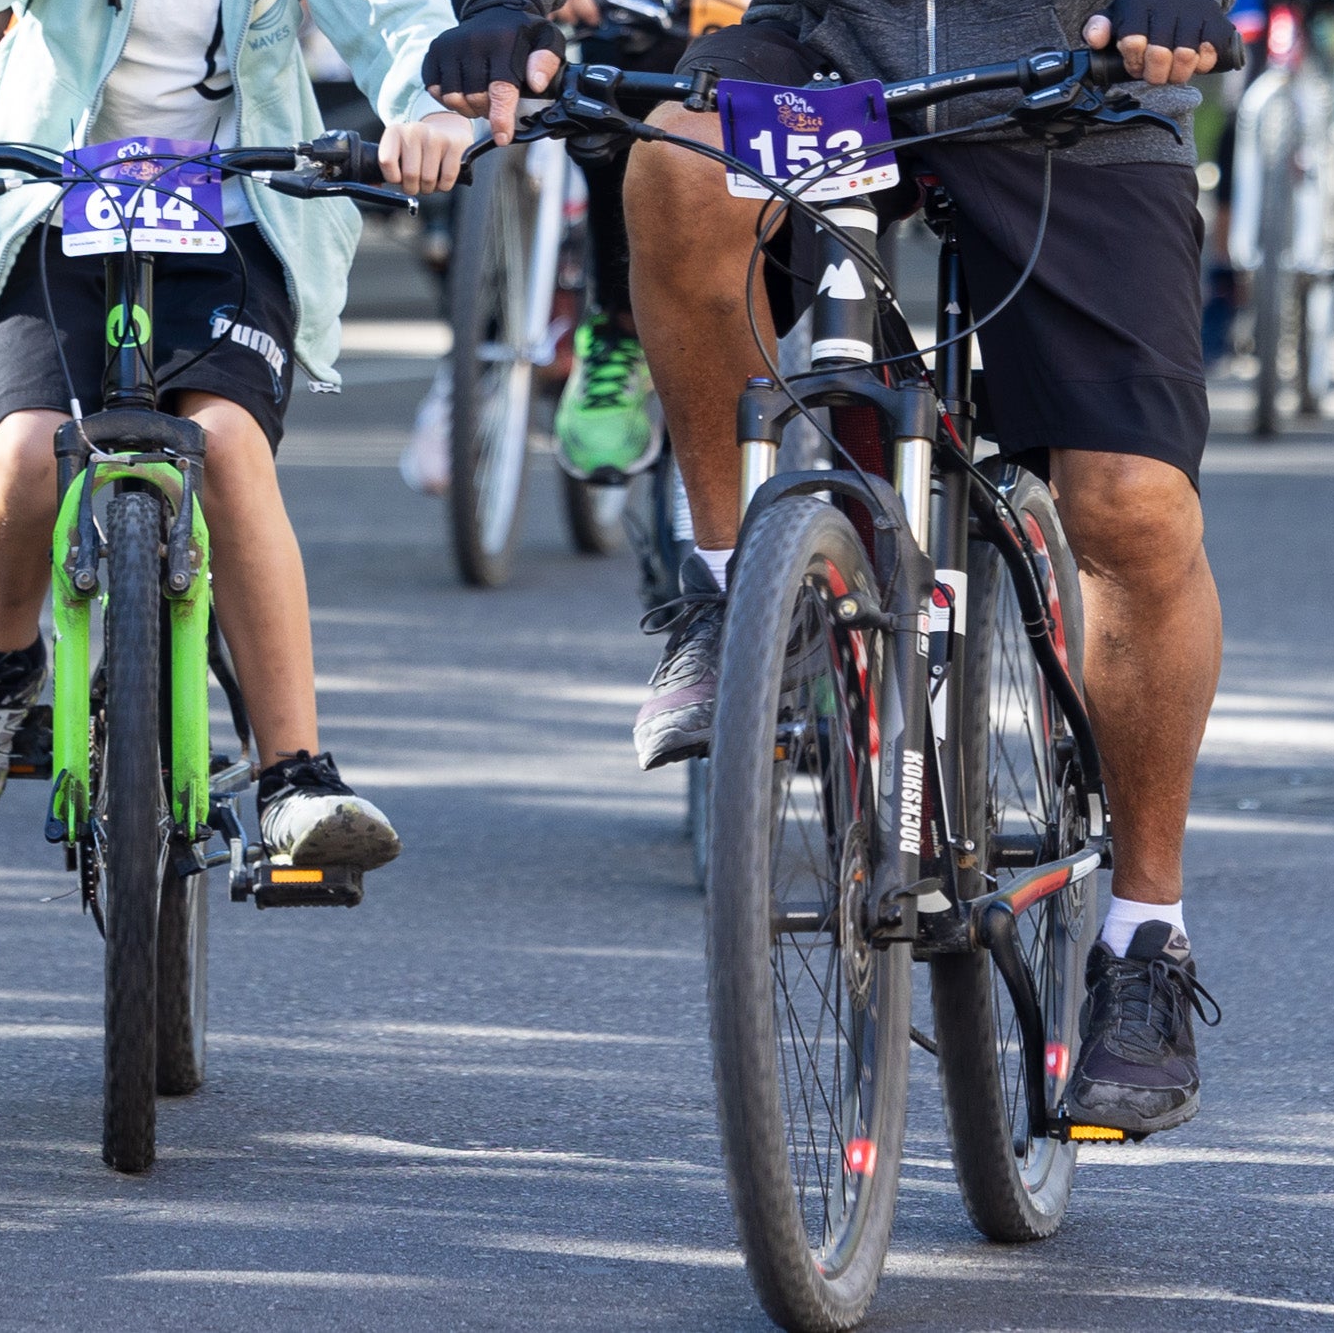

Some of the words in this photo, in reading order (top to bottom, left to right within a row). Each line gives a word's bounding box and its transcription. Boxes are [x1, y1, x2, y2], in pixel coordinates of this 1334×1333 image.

[248, 26, 290, 51] WAVES
[749, 130, 866, 178] 153
[85, 185, 199, 230] 644
[211, 317, 284, 377] PUMA
[899, 749, 924, 855] ROCKSHOX
